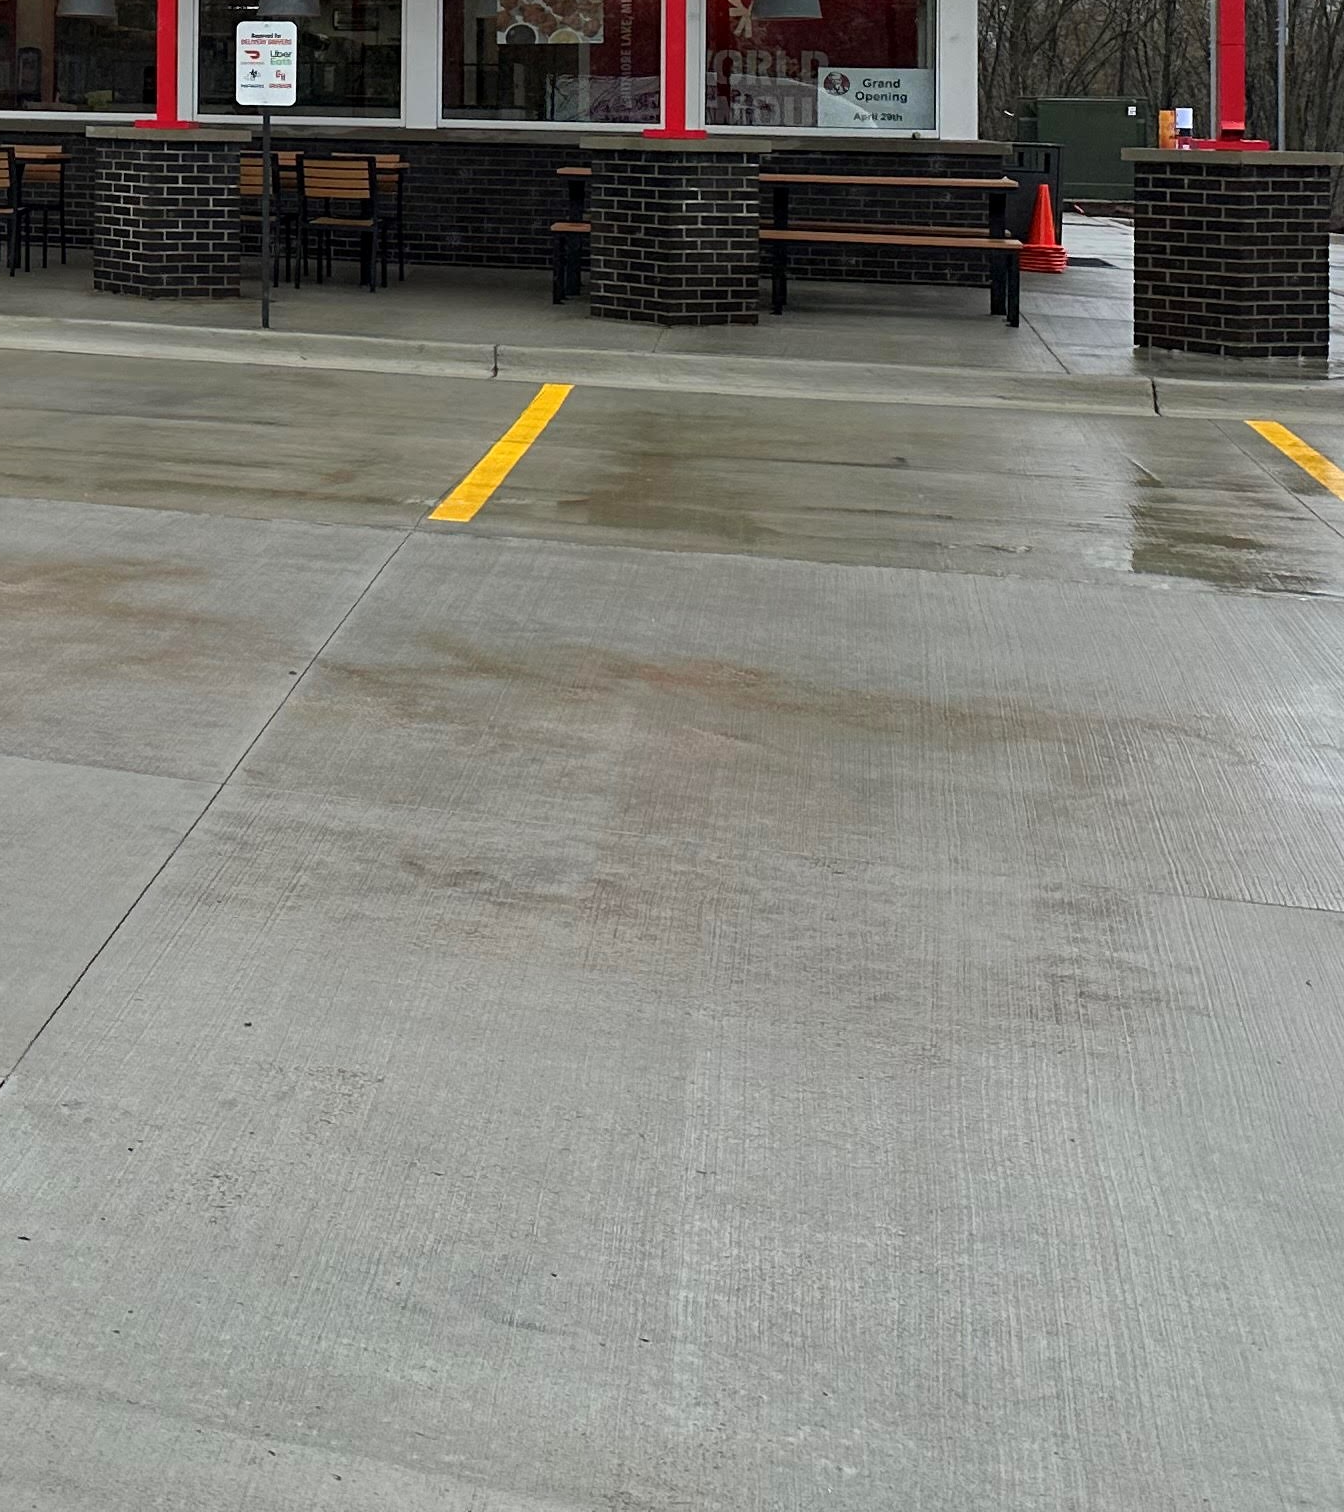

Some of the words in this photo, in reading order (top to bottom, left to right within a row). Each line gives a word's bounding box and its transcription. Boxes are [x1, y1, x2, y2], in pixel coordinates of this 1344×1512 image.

[706, 49, 830, 85] ORLD
[862, 78, 901, 88] Grand
[855, 91, 907, 103] Opening
[853, 112, 878, 121] April
